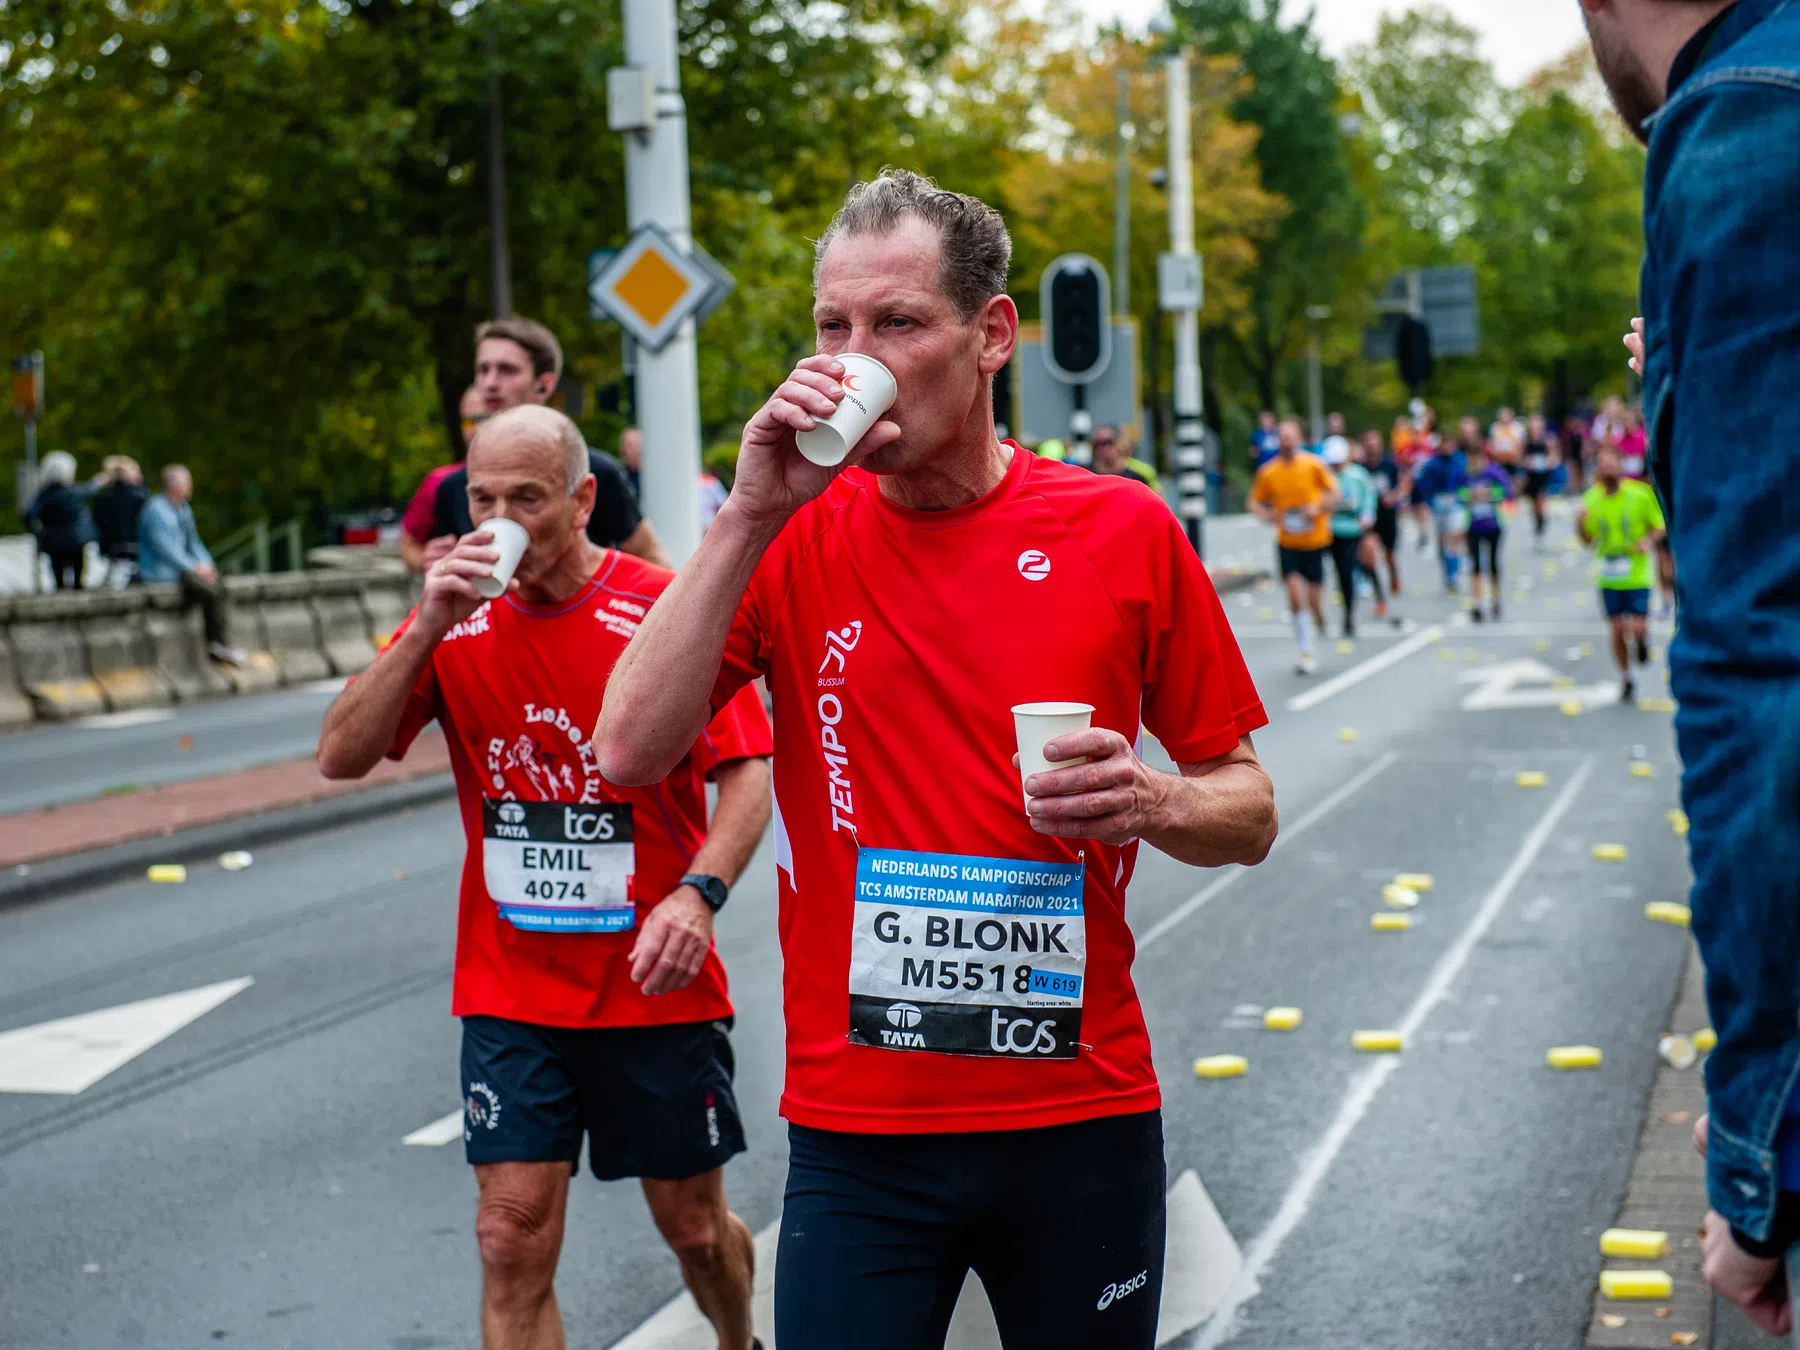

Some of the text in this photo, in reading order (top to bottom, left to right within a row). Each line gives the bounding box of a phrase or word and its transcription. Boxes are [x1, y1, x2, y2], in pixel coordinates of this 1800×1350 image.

[844, 393, 867, 415] mpion
[817, 676, 845, 687] BUSSUM
[817, 693, 857, 834] TEMPO
[494, 823, 530, 839] TATA
[564, 806, 615, 841] tcs
[522, 847, 592, 872] EMIL
[871, 858, 1072, 887] NEDERLANDS KAMPIOENSCHAP
[524, 880, 586, 901] 4074
[859, 881, 1079, 910] TCS AMSTERDAM MARATHON 2021
[873, 911, 1069, 953] G. BLONK
[901, 957, 1032, 994] M5518
[1035, 974, 1077, 993] W 619
[880, 1029, 926, 1048] TATA
[990, 1008, 1056, 1054] tcs
